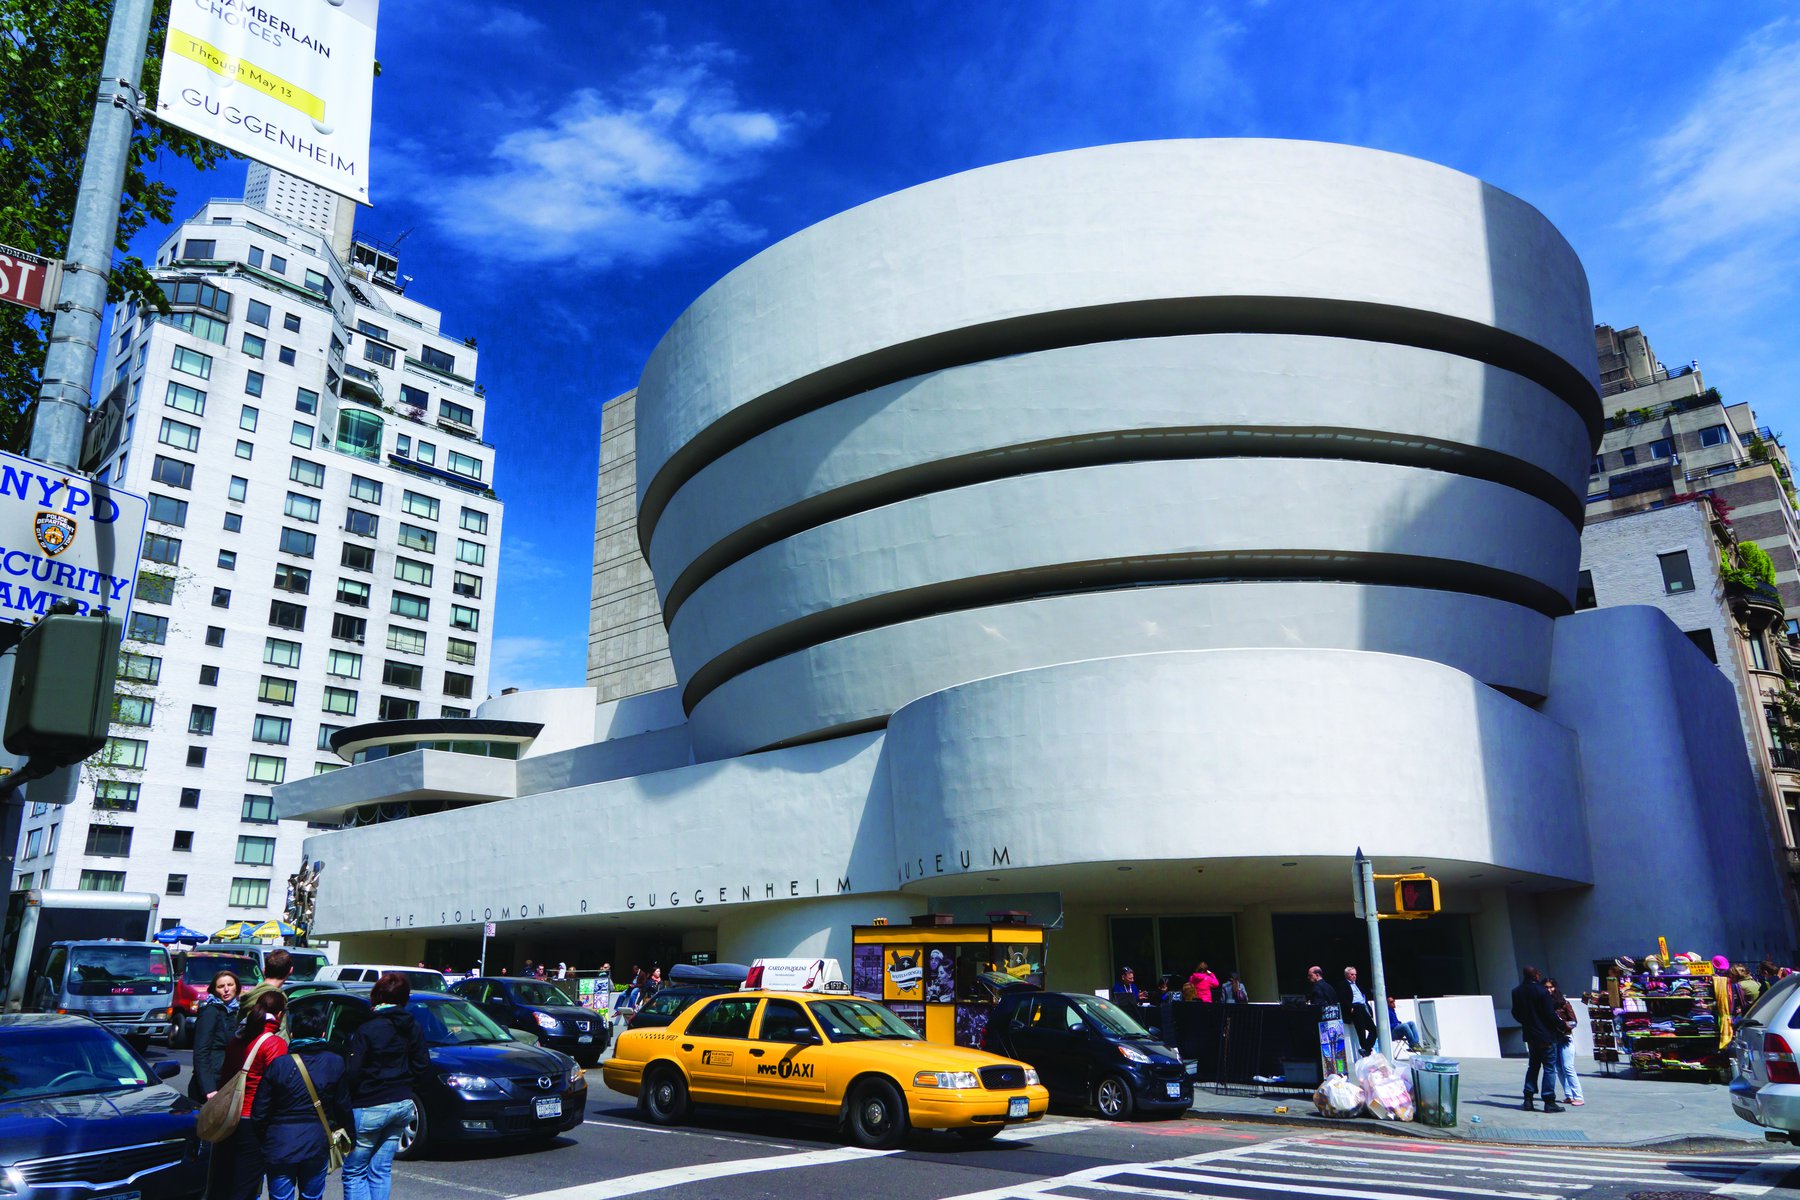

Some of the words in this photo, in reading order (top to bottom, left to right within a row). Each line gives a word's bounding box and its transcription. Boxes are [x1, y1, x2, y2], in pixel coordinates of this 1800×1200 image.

[220, 0, 331, 59] AMBERLAIN
[189, 40, 245, 75] Through
[249, 69, 276, 91] May
[281, 86, 292, 98] 13
[181, 88, 355, 176] GUGGENHEIM
[0, 464, 120, 524] NYPD
[46, 513, 68, 524] POLICE
[36, 518, 75, 533] DEPARTMENT
[384, 914, 414, 929] THE
[441, 903, 545, 925] SOLOMON
[580, 899, 587, 913] R
[626, 876, 852, 909] GUGGENHEIM
[898, 846, 1012, 883] USEUM
[757, 1064, 777, 1075] NYC
[778, 1058, 814, 1078] TAXI
